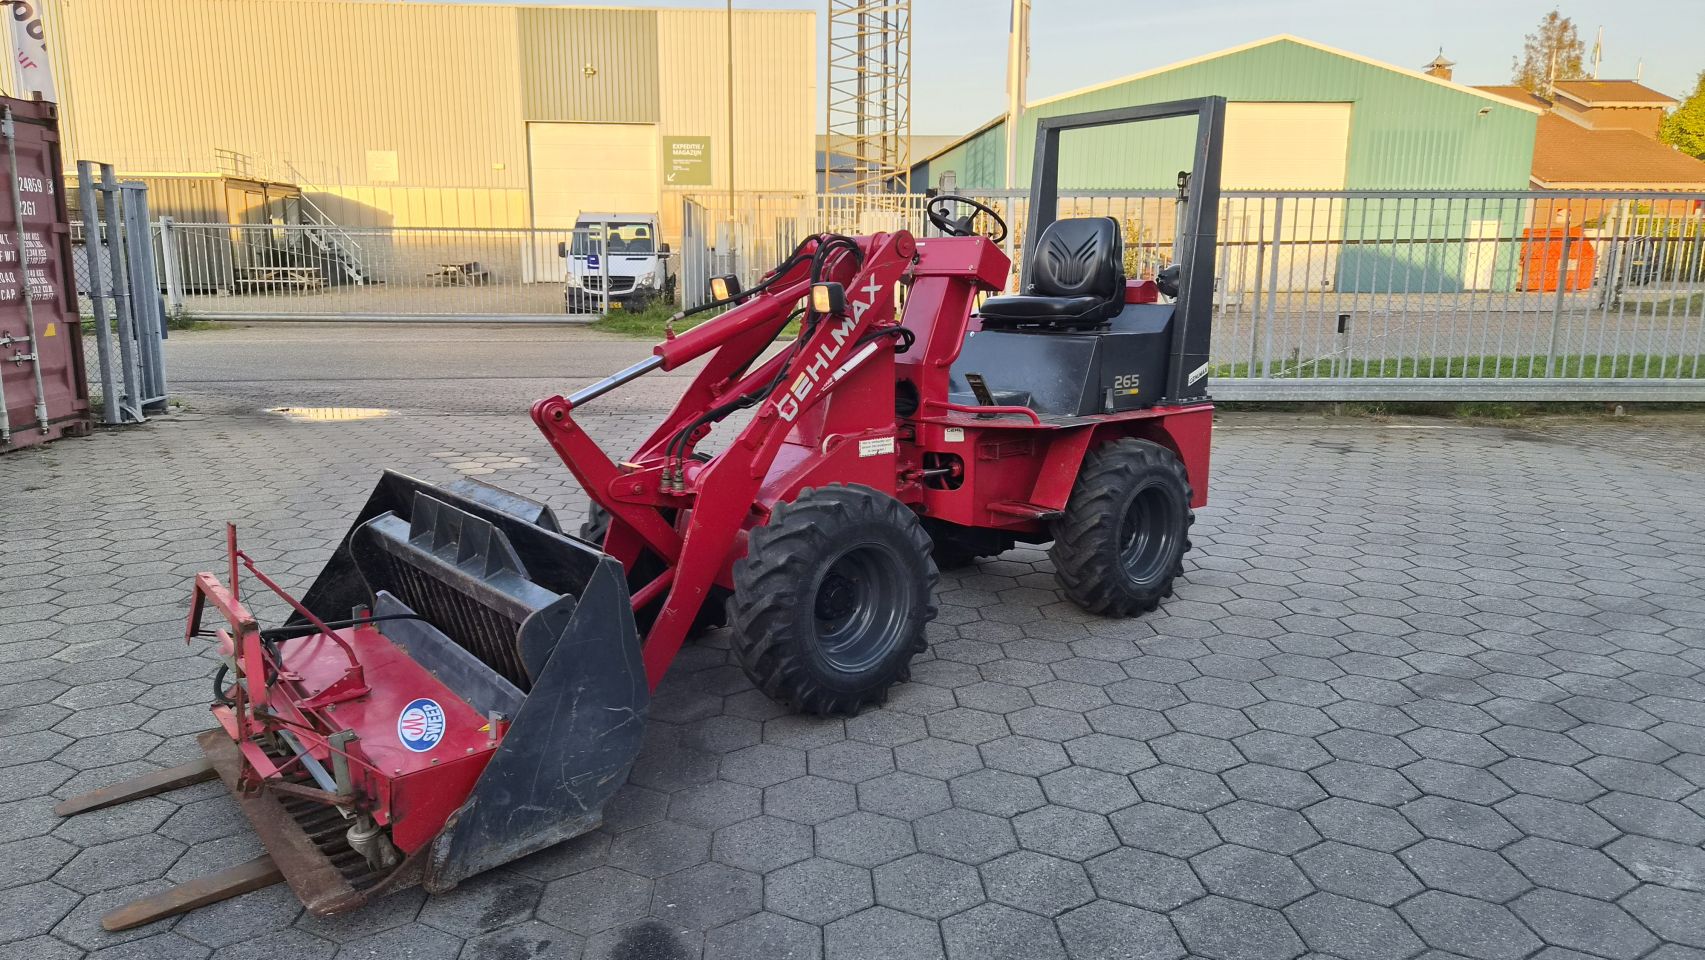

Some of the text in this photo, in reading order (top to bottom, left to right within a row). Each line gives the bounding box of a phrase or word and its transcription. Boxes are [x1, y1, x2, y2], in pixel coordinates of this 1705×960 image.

[19, 176, 43, 193] 24859
[777, 273, 883, 422] GEHLMAX
[1114, 374, 1140, 389] 265
[422, 704, 442, 741] SWEEP
